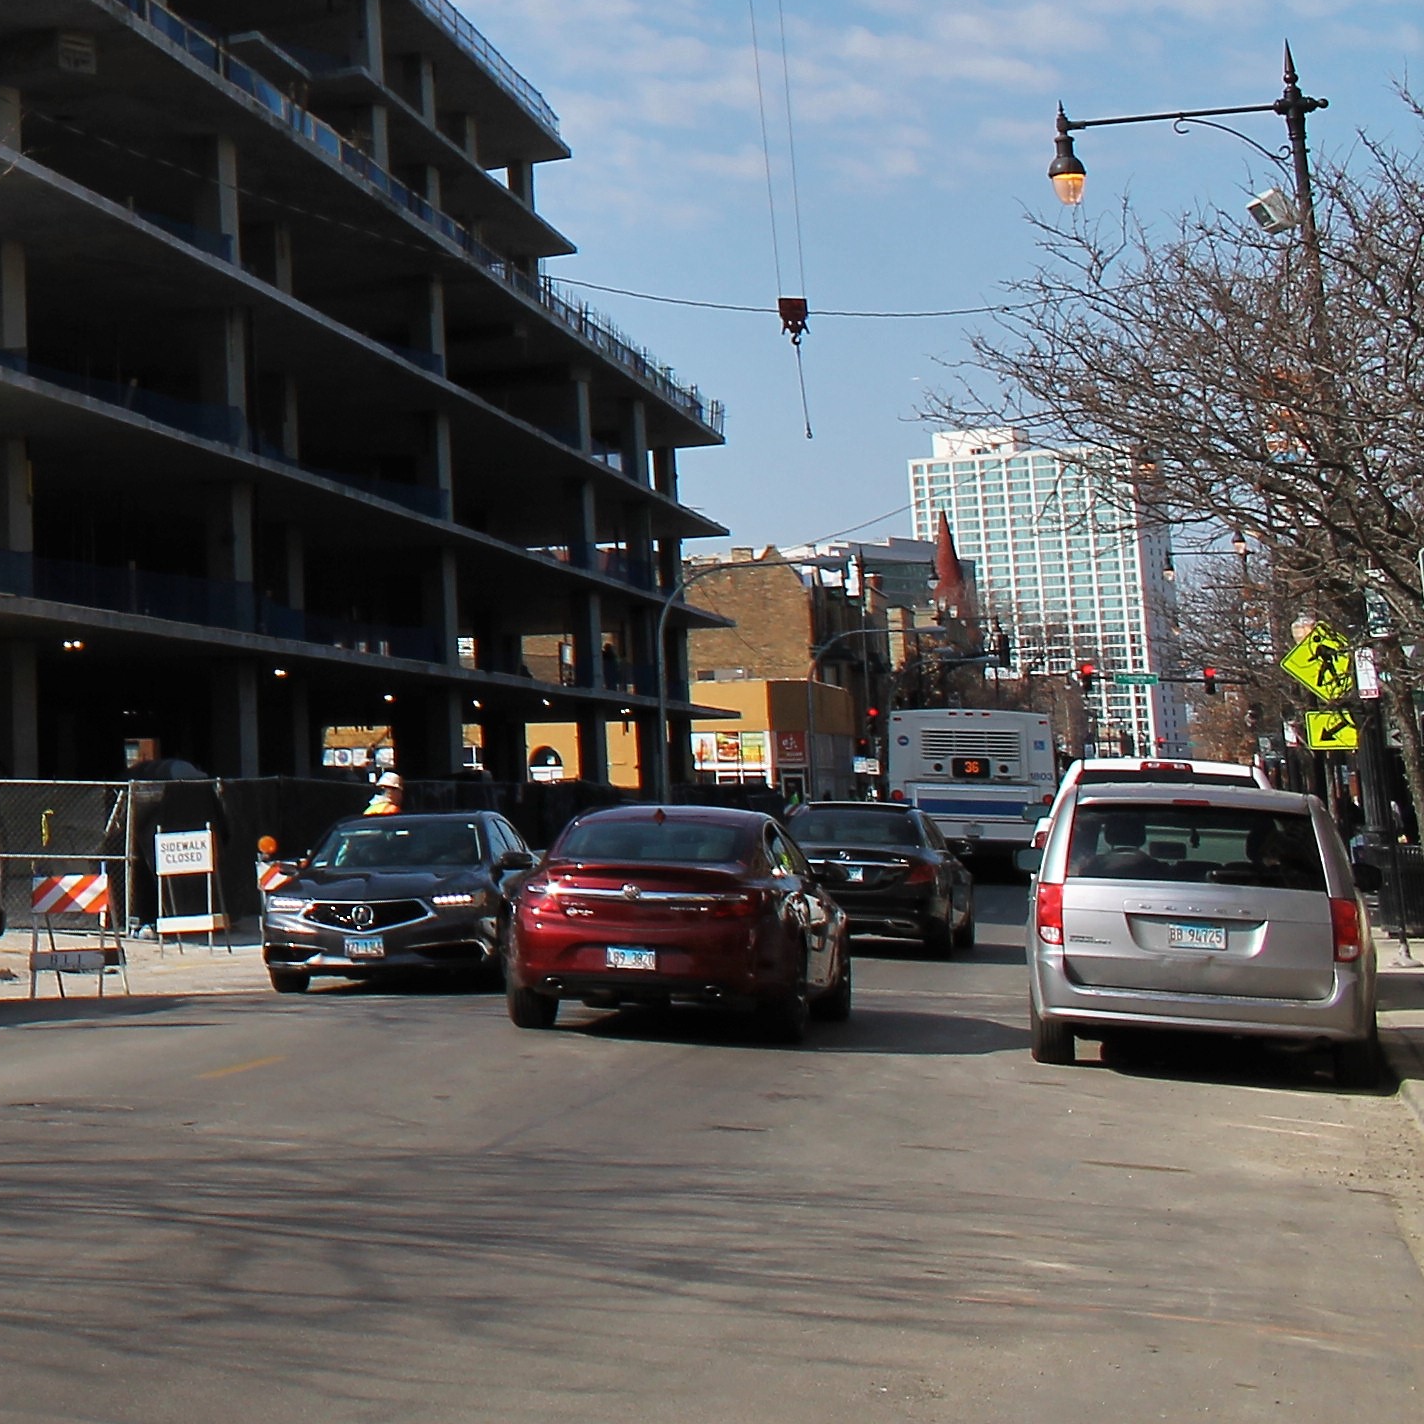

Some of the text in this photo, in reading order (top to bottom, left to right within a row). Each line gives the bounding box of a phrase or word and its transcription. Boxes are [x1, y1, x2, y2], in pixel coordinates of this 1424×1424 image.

[964, 760, 980, 774] 36
[160, 840, 208, 853] SIDEWALK
[166, 851, 203, 864] CLOSED
